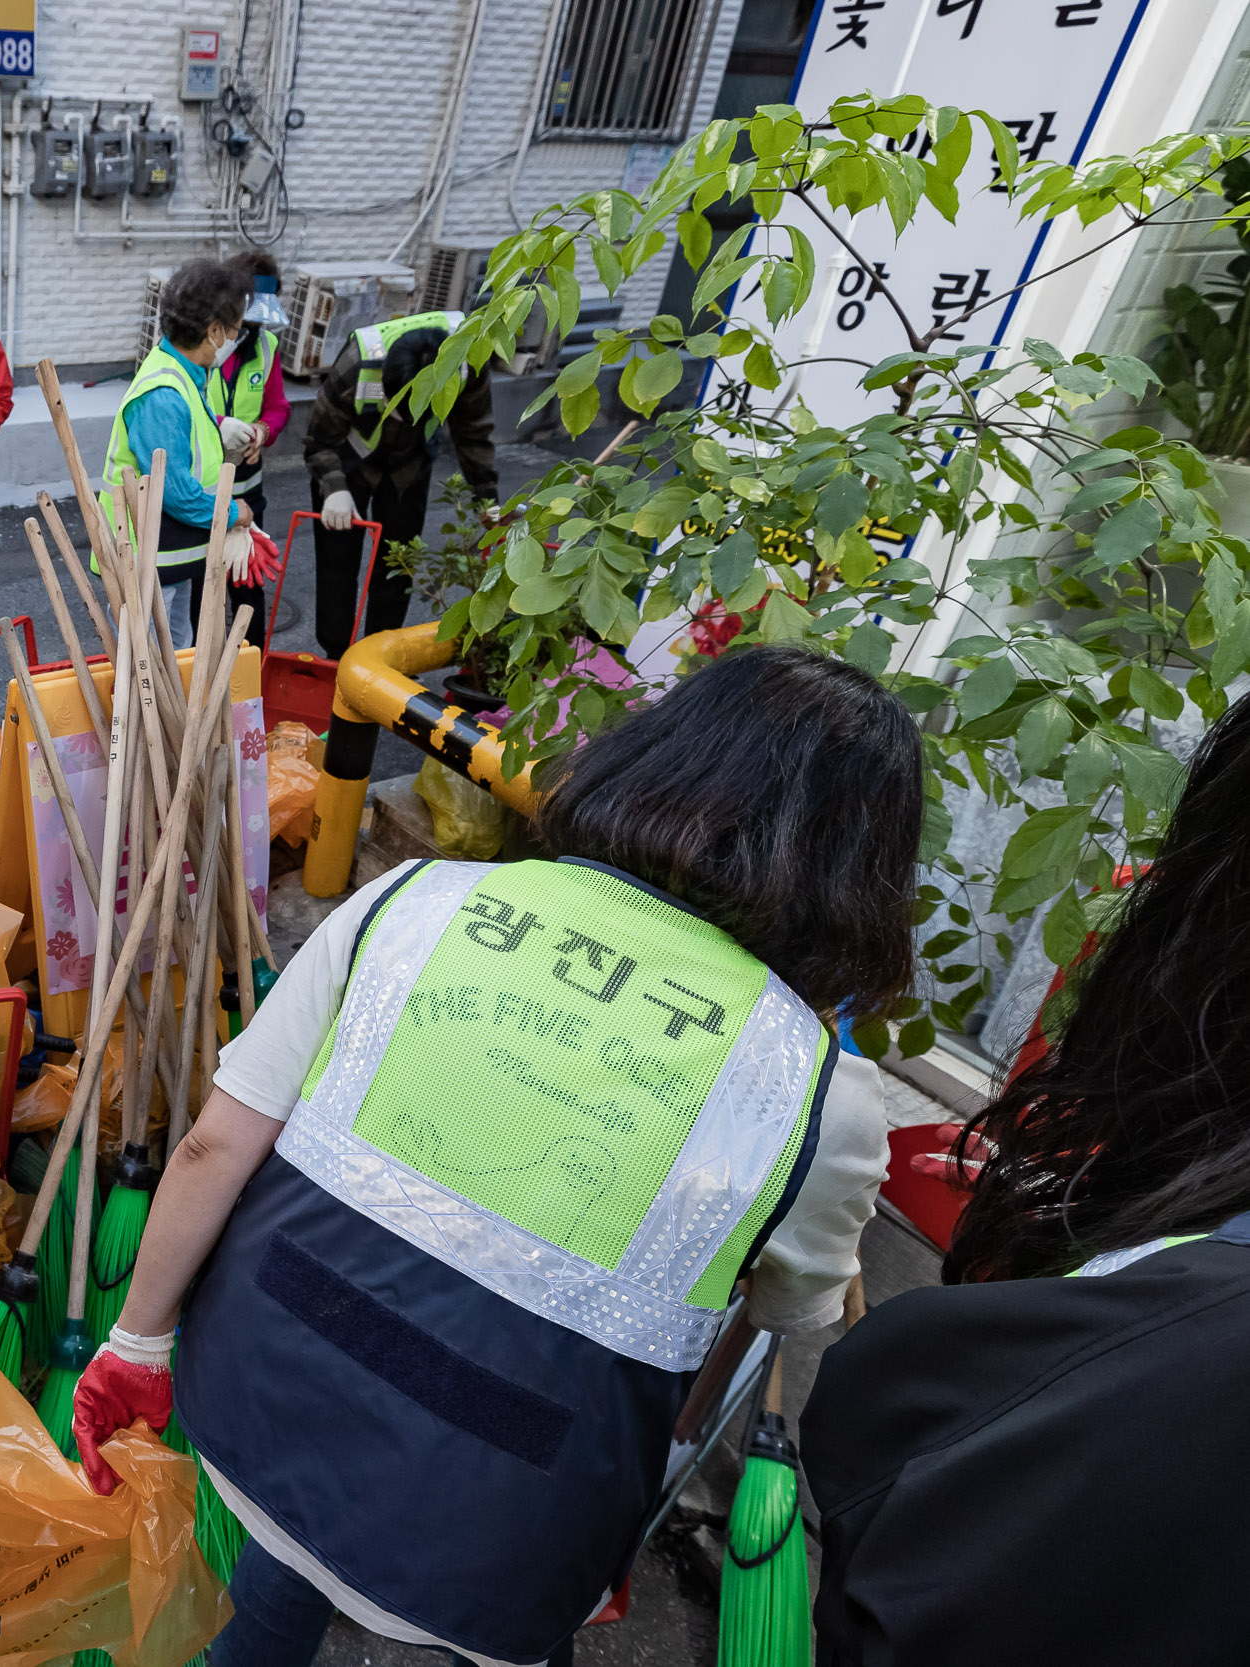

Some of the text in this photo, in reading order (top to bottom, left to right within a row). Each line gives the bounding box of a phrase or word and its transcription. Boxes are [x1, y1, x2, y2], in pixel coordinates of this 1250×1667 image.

[408, 986, 483, 1028] THE
[493, 991, 592, 1051] FIVE
[461, 892, 726, 1041] 광진구
